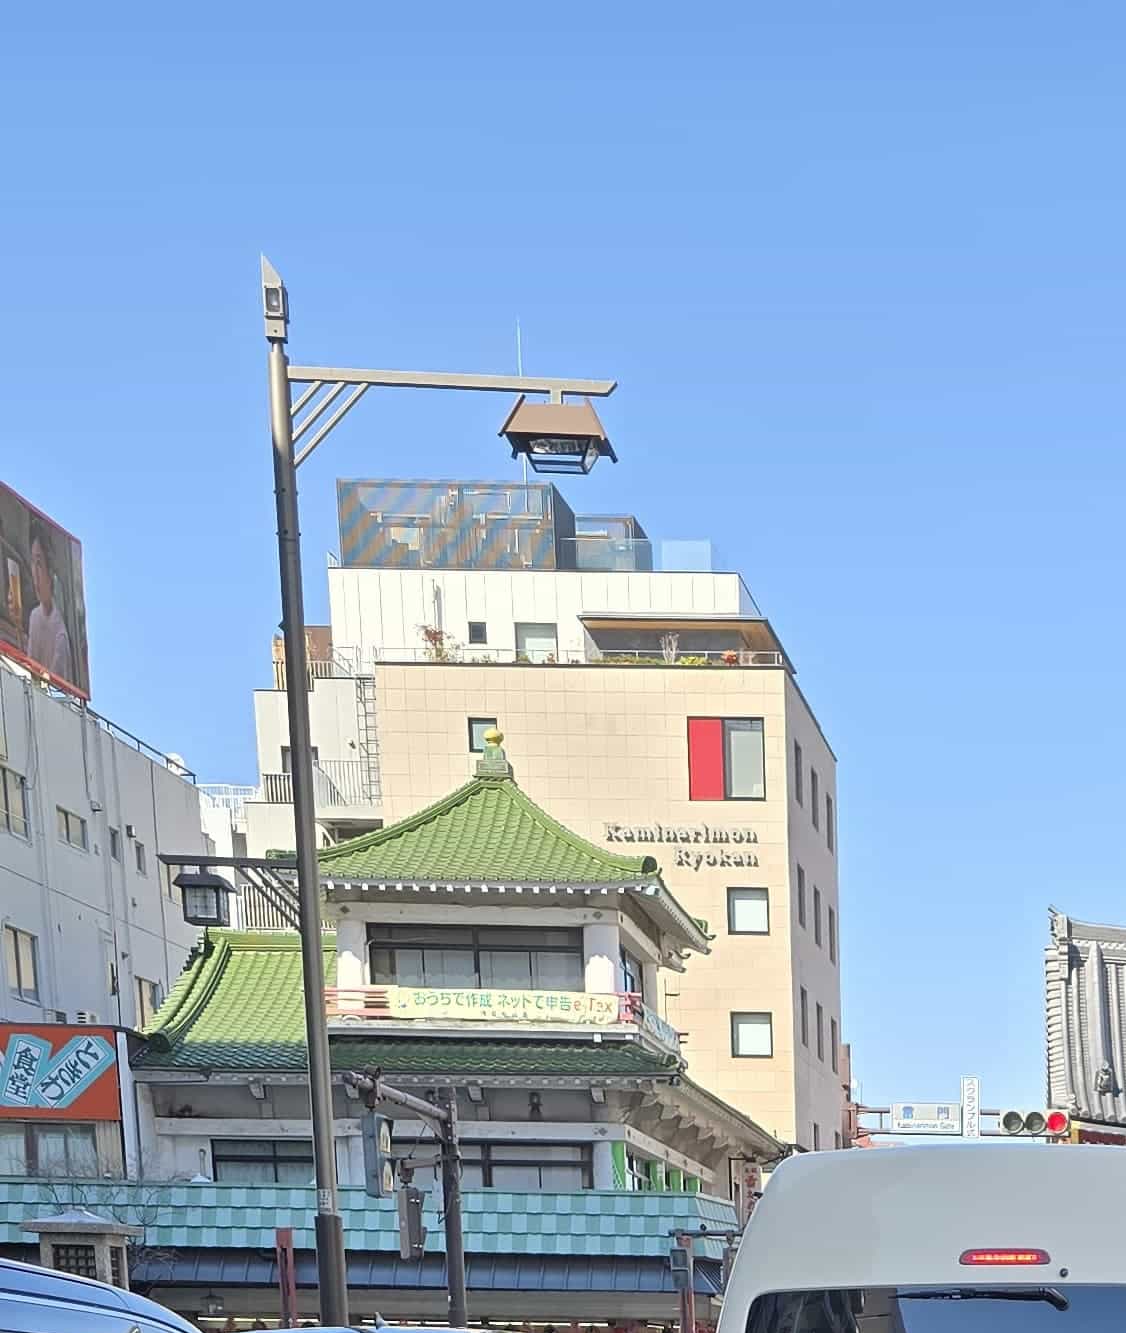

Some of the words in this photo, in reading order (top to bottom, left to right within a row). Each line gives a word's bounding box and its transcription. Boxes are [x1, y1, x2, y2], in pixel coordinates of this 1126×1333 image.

[603, 822, 759, 844] Kaminarimon
[674, 846, 760, 871] Ryokan
[6, 1046, 38, 1100] 食堂
